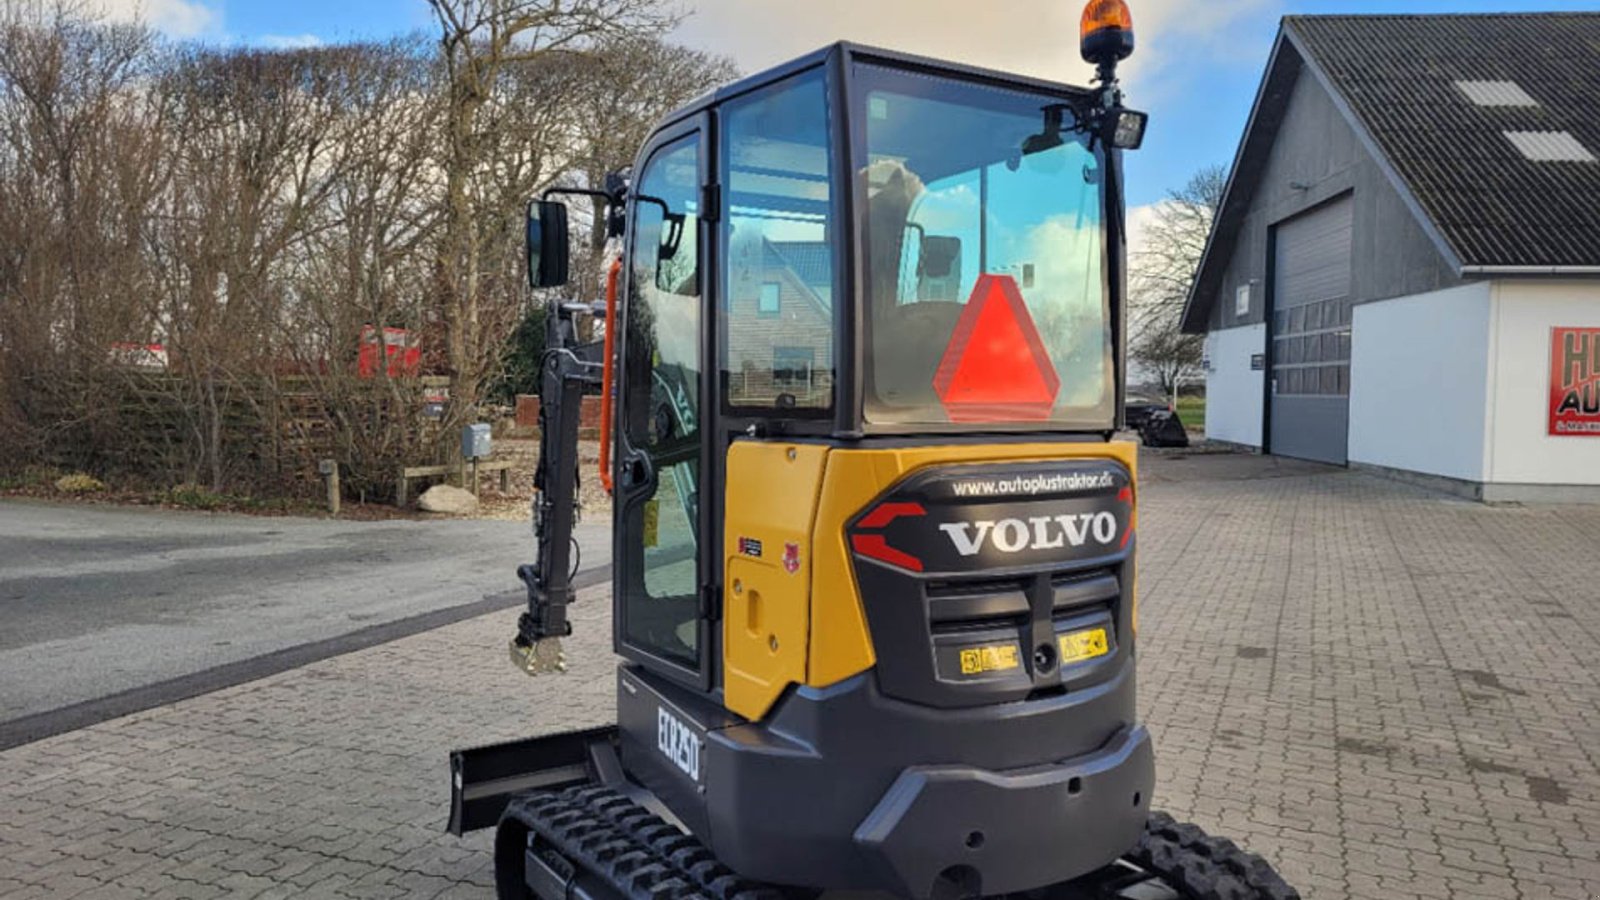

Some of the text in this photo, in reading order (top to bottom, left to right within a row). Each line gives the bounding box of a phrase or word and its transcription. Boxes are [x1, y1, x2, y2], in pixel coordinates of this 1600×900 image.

[952, 471, 1114, 496] www.autoplustraktor.dk
[939, 511, 1117, 556] VOLVO
[658, 706, 699, 781] ECR25D
